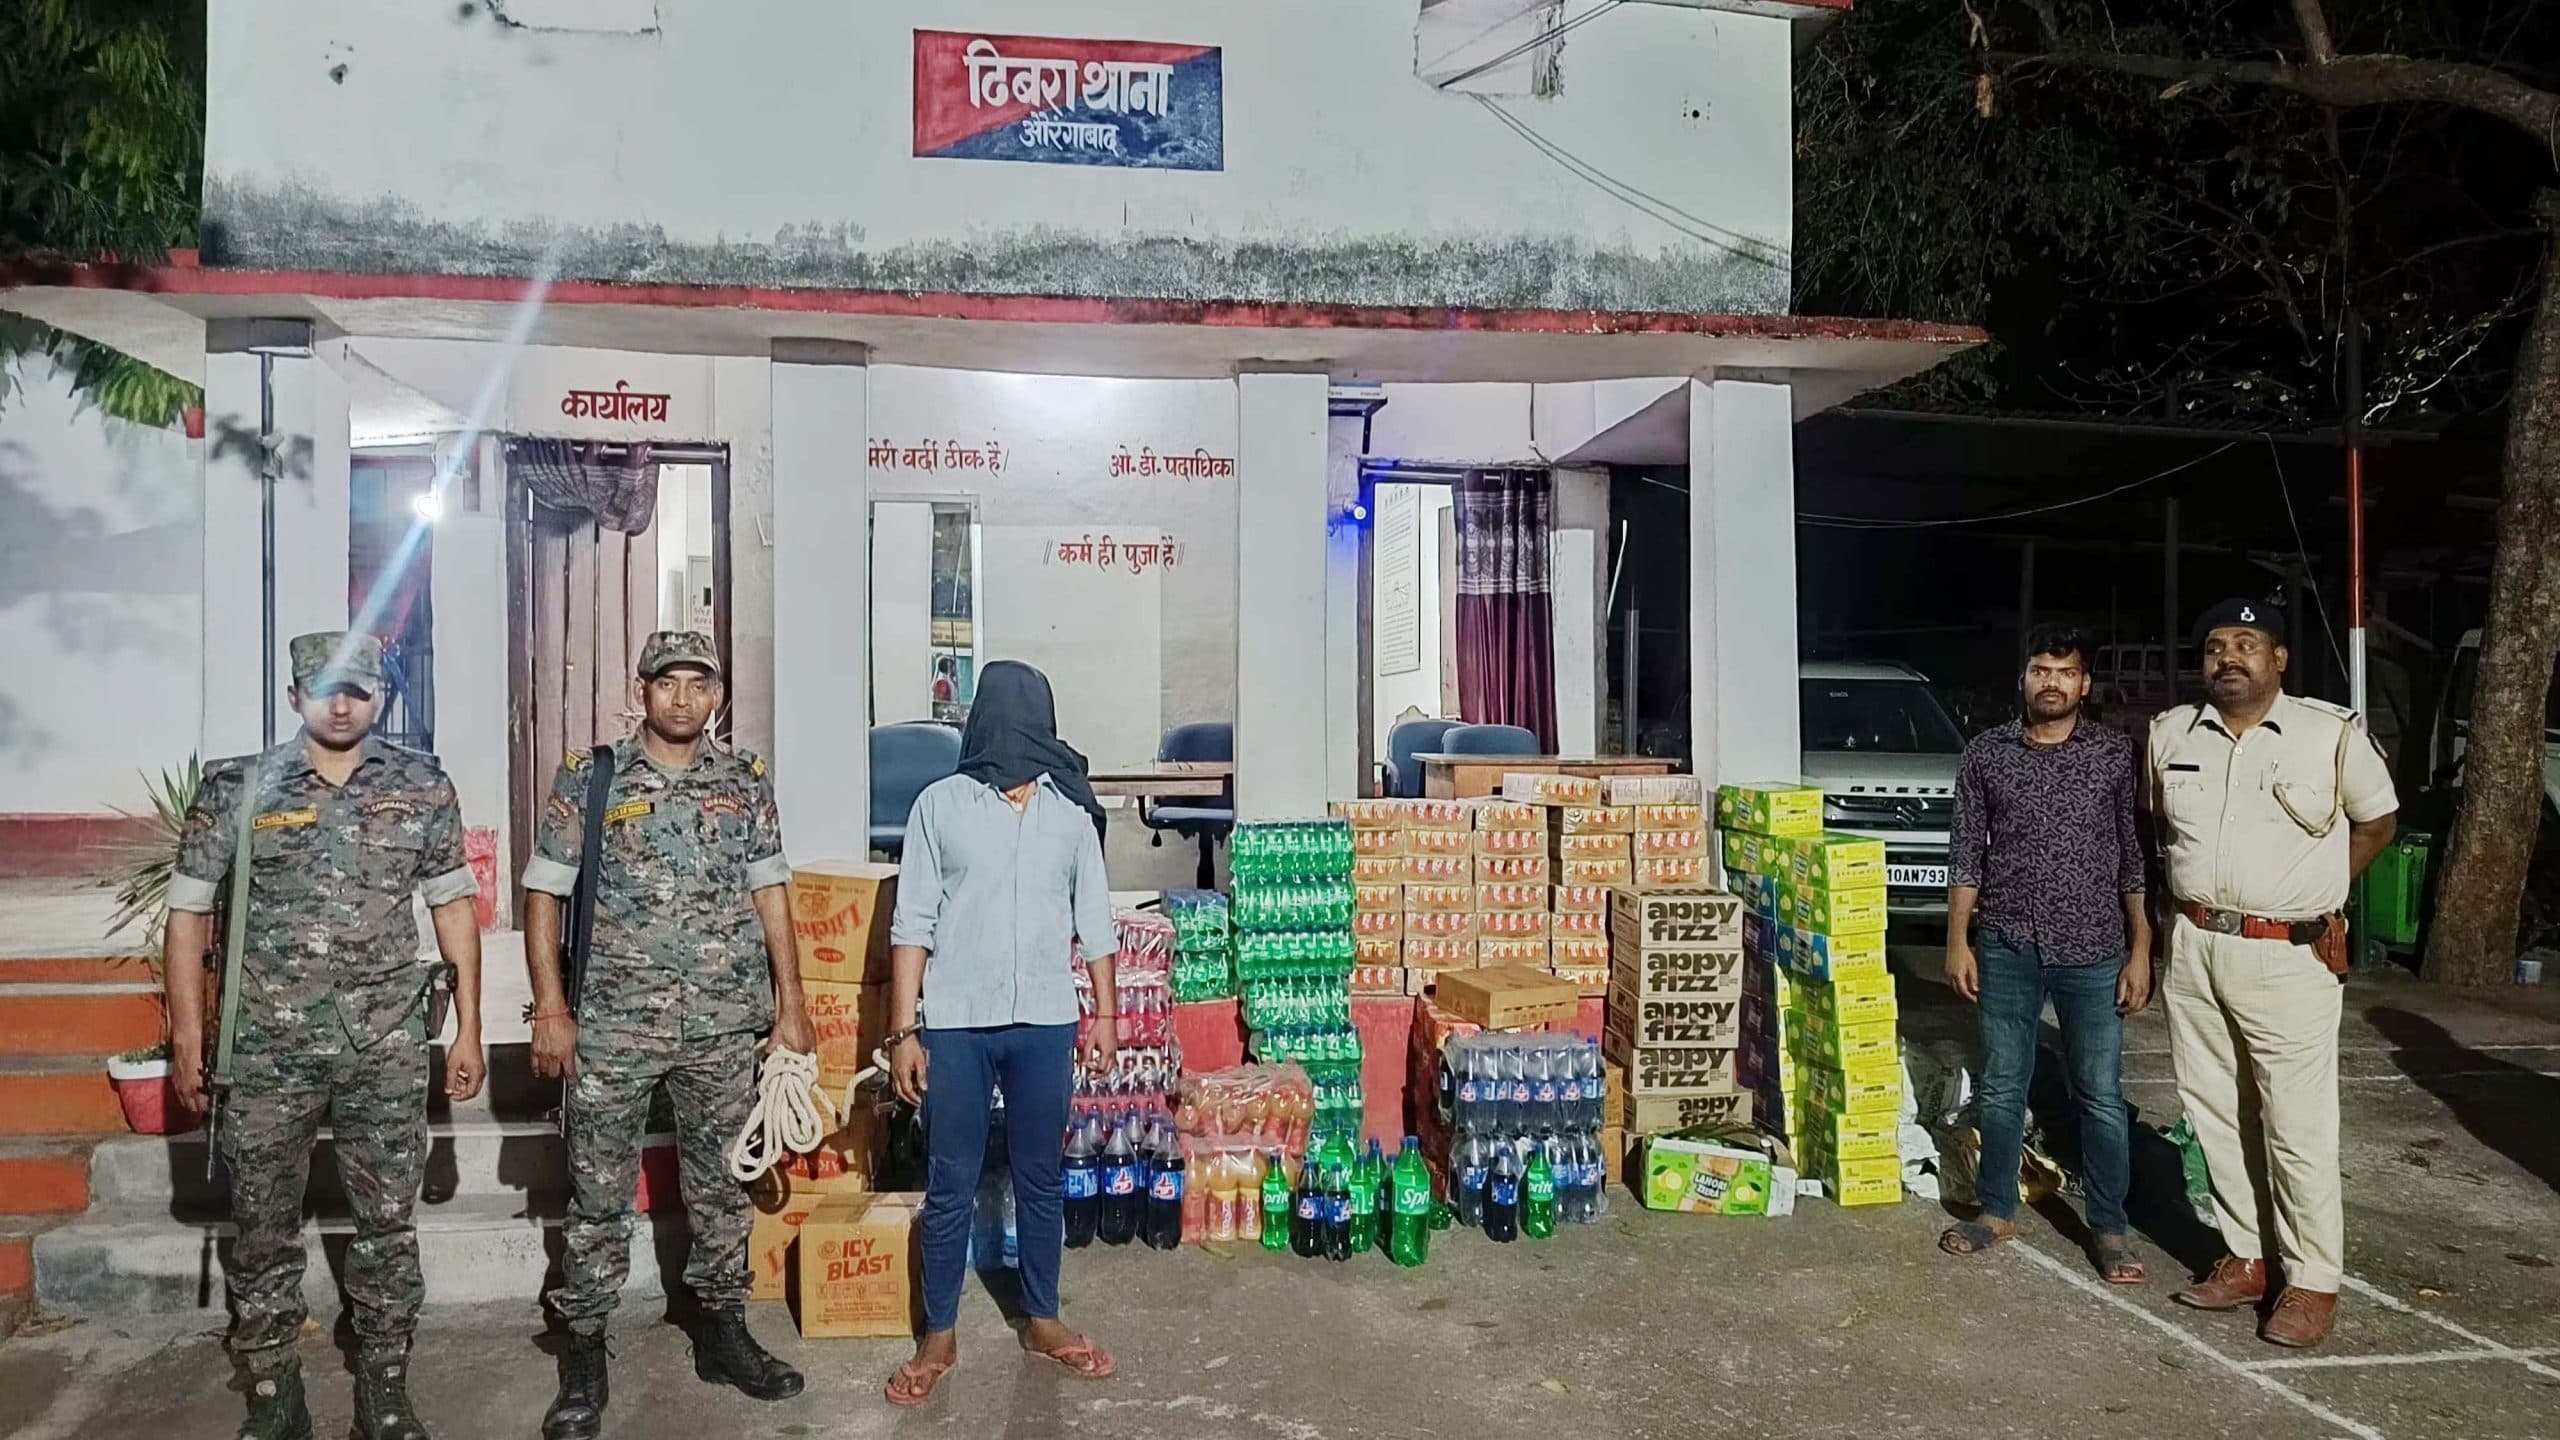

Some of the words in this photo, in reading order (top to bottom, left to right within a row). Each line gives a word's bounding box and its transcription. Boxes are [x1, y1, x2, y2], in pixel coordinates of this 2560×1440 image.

[963, 39, 1079, 117] ढिबरा
[1082, 61, 1175, 118] थाना
[1019, 111, 1120, 158] औरंगाबाद
[561, 380, 671, 423] कार्यालय
[902, 439, 939, 475] वर्दी
[945, 440, 984, 469] ठीक
[1058, 534, 1093, 564] कर्म
[1097, 535, 1117, 573] ही
[1122, 544, 1159, 575] पुजा
[1647, 902, 1738, 924] appy
[1648, 920, 1718, 941] fizz
[1647, 953, 1738, 975] appy
[1648, 971, 1718, 992] fizz
[815, 994, 839, 1005] ICY
[1644, 1002, 1735, 1024] appy
[1644, 1020, 1714, 1041] fizz
[1639, 1049, 1729, 1069] appy
[1640, 1067, 1708, 1088] fizz
[1678, 1096, 1740, 1113] appy
[842, 1238, 876, 1258] ICY
[828, 1254, 894, 1281] BLAST
